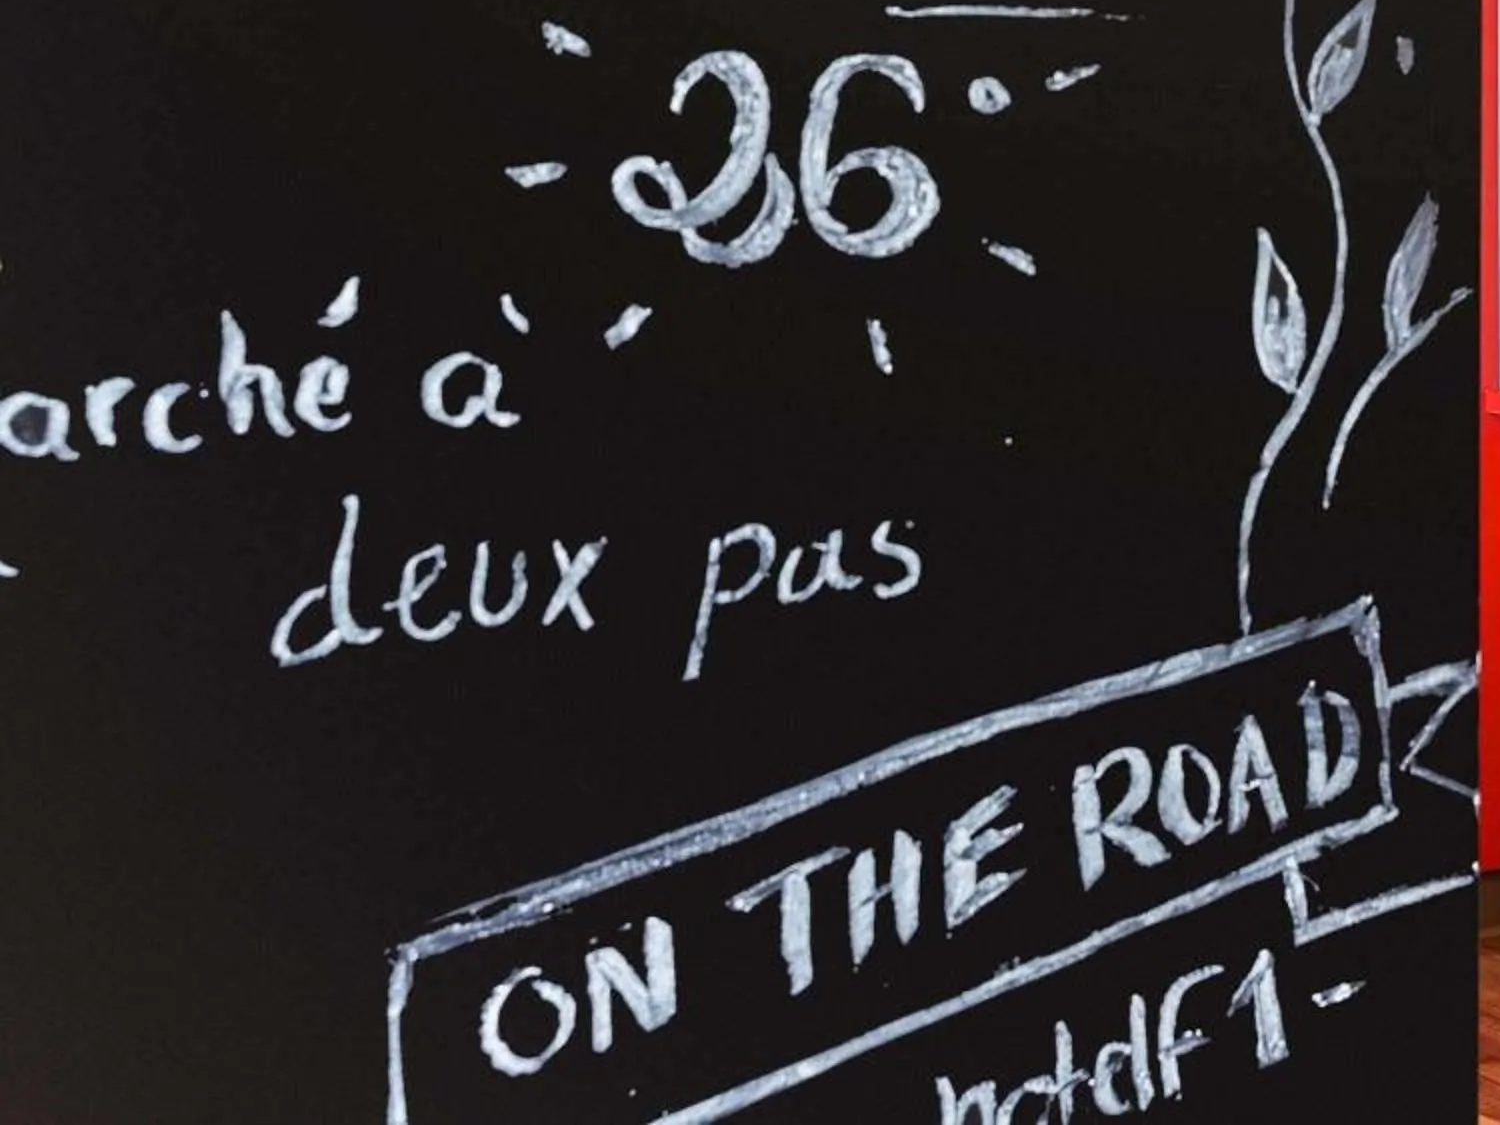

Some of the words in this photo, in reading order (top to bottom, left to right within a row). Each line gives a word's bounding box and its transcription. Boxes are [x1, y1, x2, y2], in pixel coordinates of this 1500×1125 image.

[421, 293, 522, 428] à
[270, 494, 608, 667] deux
[682, 520, 924, 681] pas
[479, 915, 676, 1076] ON
[725, 785, 1027, 995] THE
[1071, 679, 1363, 890] ROAD
